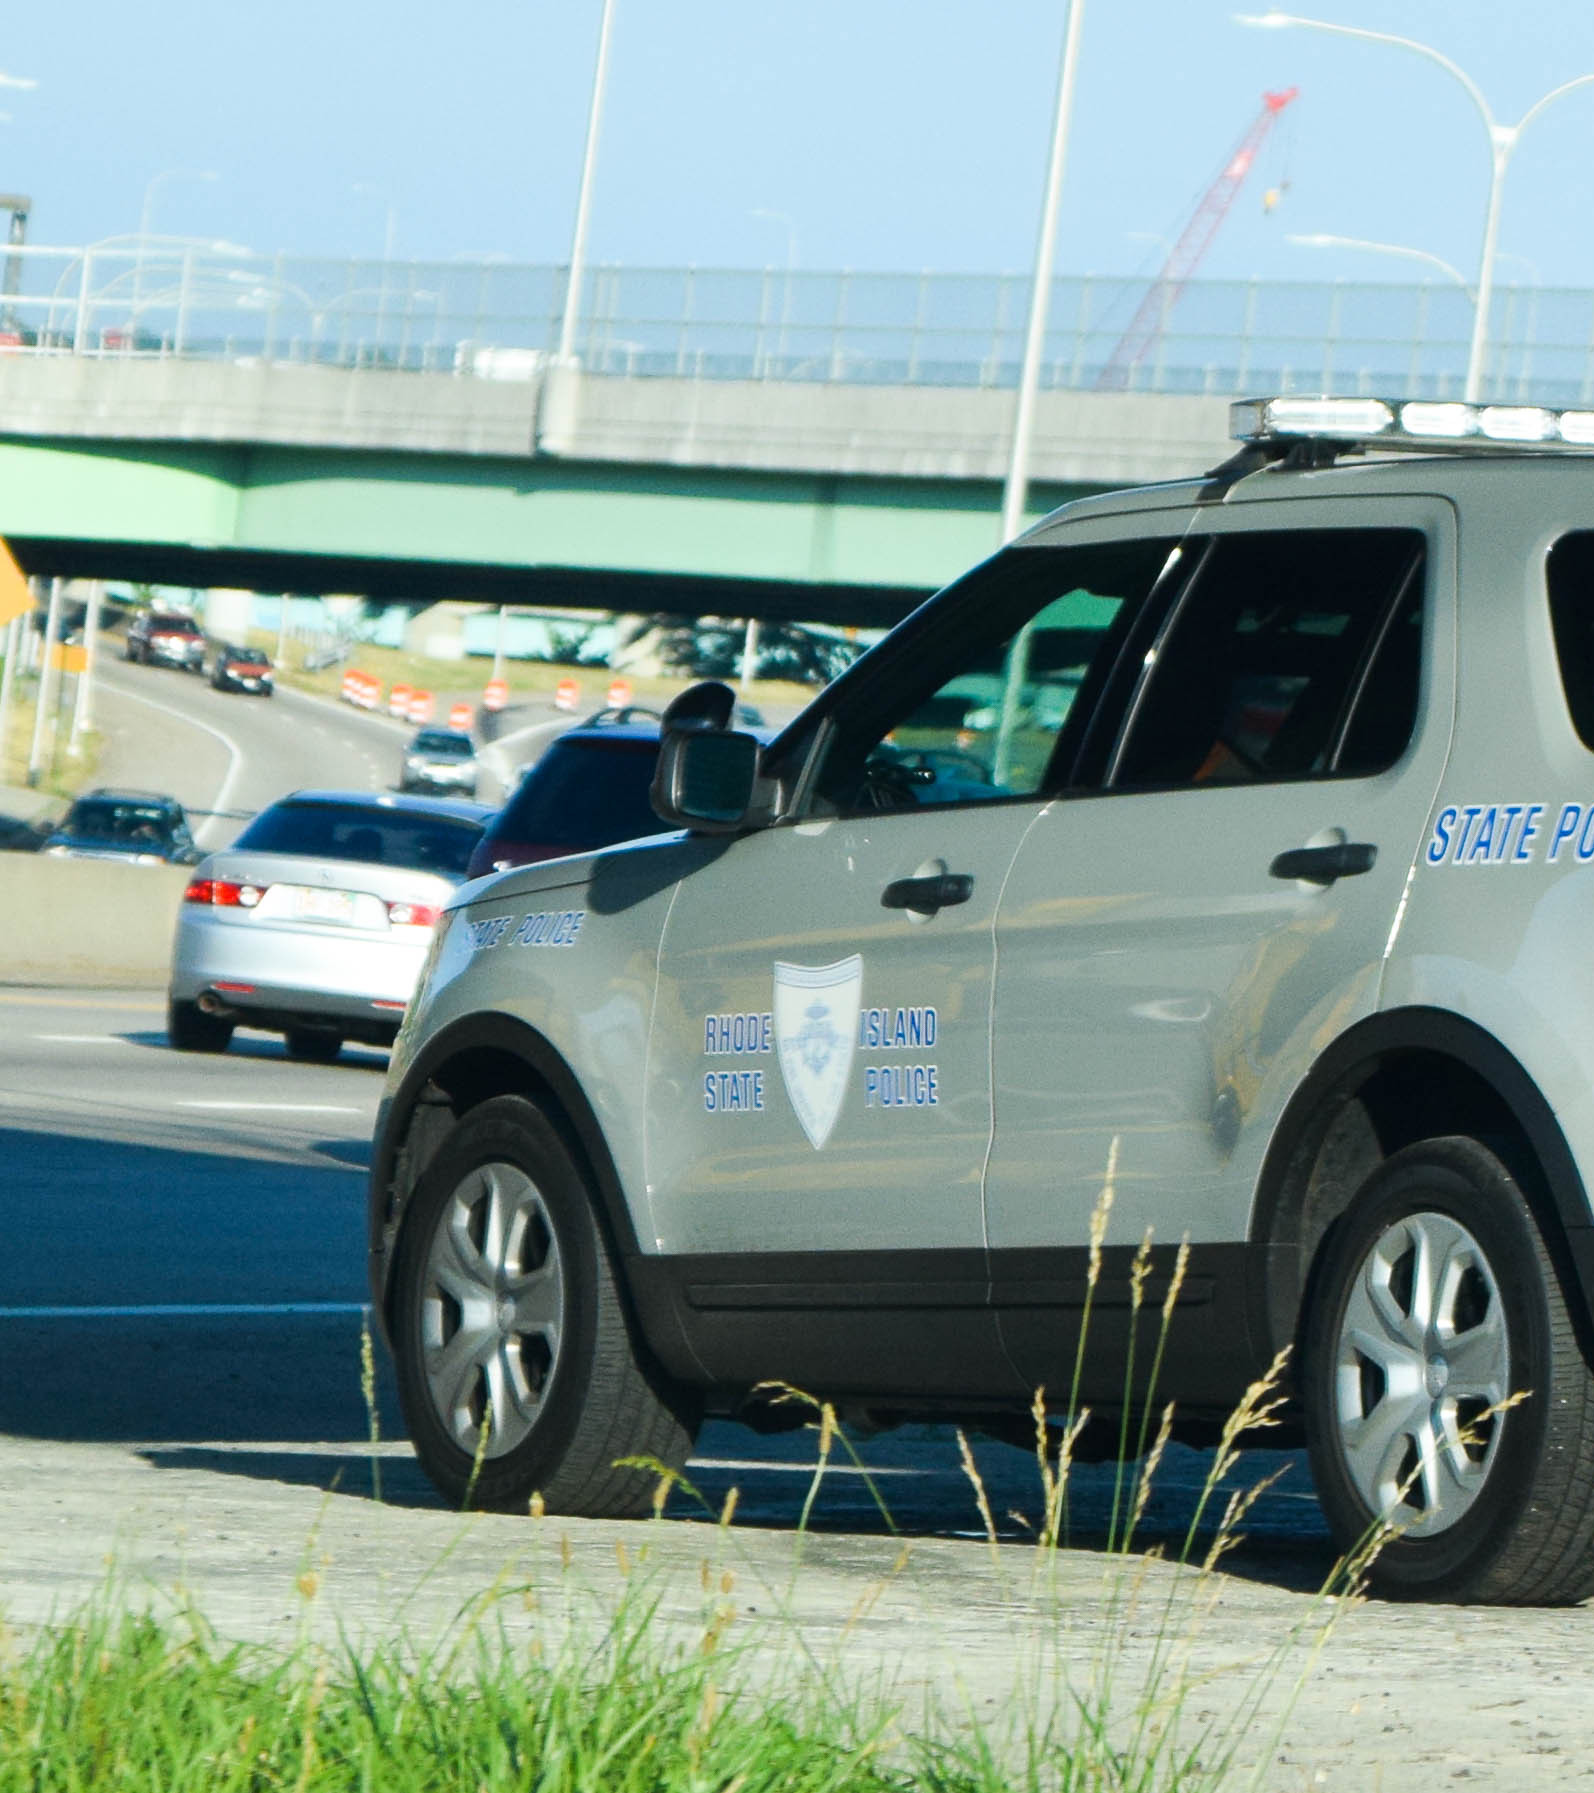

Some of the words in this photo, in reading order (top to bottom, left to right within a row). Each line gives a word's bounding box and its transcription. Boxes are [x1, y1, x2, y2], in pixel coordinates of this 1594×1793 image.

[1426, 802, 1549, 866] STATE
[507, 911, 587, 947] POLICE
[703, 1012, 772, 1056] RHODE
[858, 1006, 938, 1049] ISLAND
[703, 1070, 765, 1112] STATE
[864, 1064, 939, 1108] POLICE
